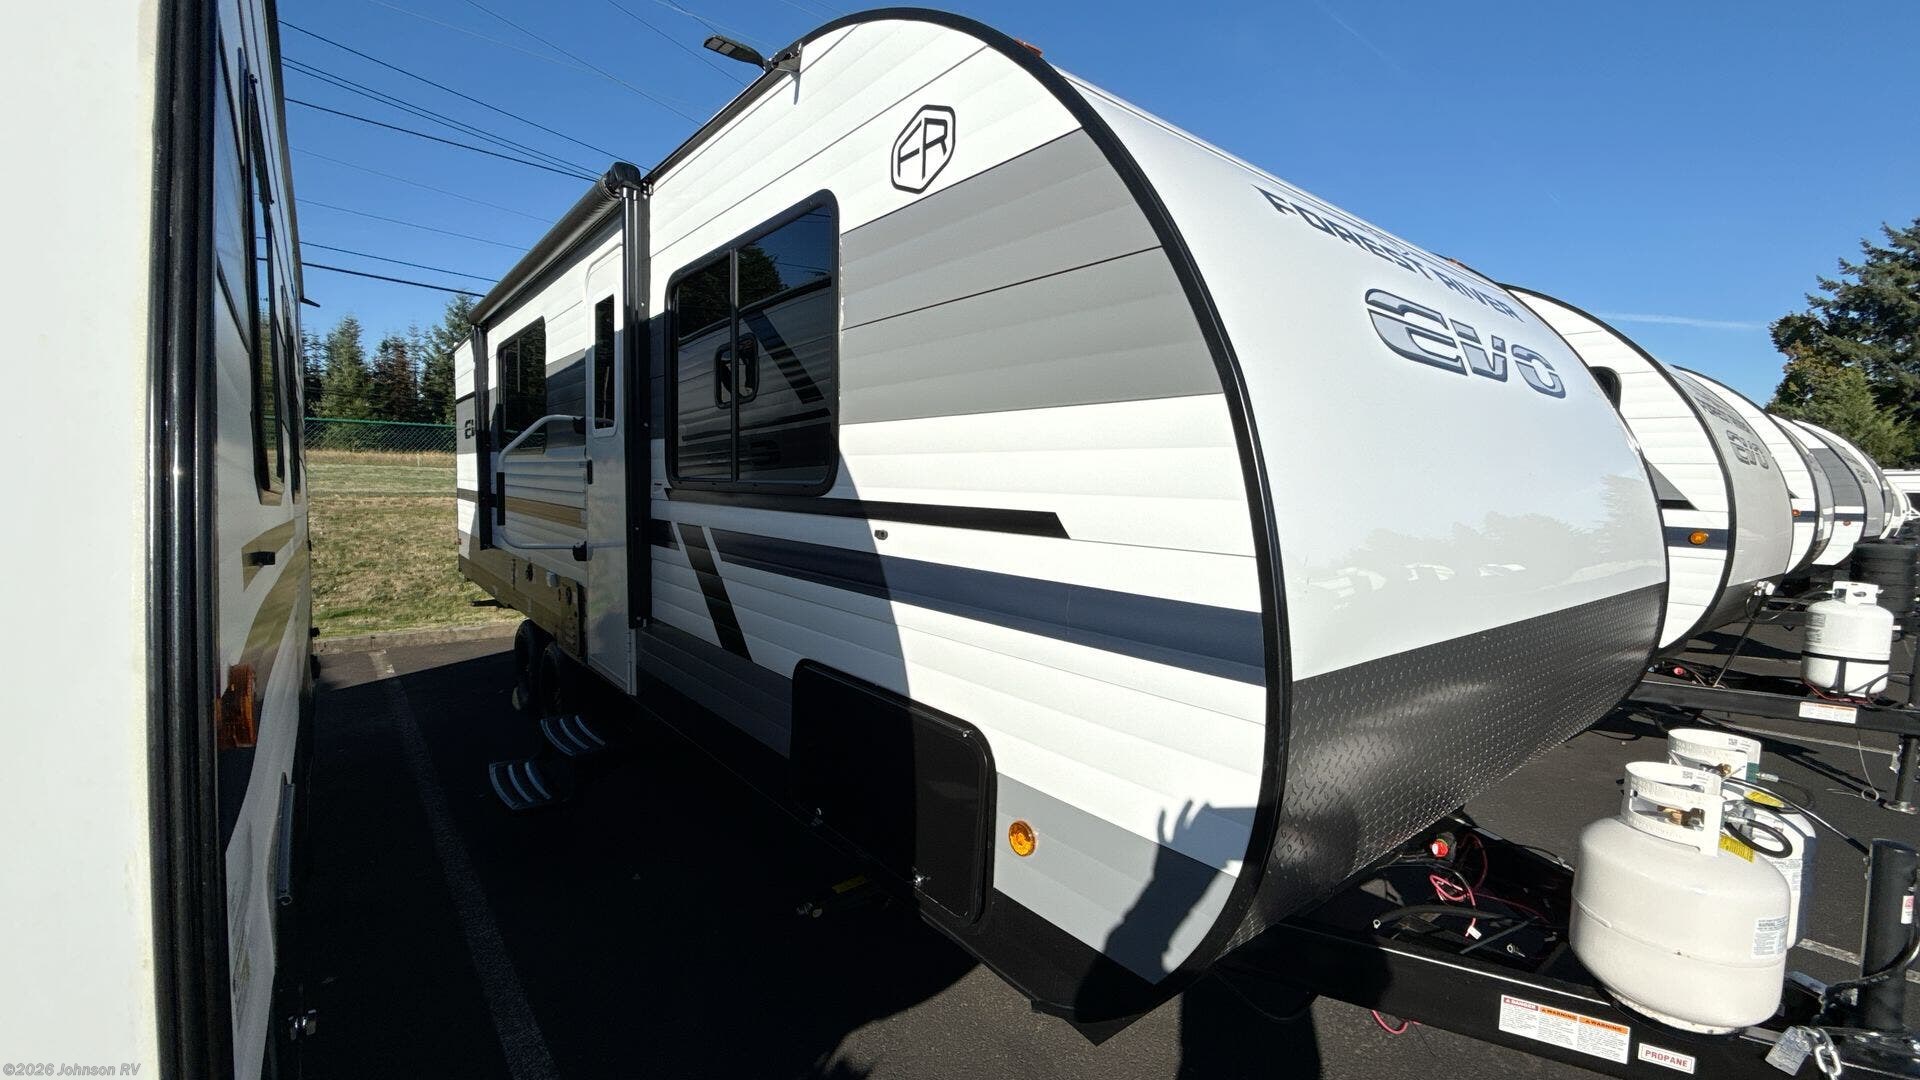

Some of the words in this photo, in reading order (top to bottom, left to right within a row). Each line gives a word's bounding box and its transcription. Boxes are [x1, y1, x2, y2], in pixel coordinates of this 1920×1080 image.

[1250, 183, 1433, 281] FOREST
[1427, 265, 1526, 324] RIVER
[1364, 287, 1567, 400] EVO
[1546, 1008, 1577, 1020] WARNING
[1590, 1020, 1623, 1033] WARNING
[1644, 1049, 1689, 1068] PROPANE
